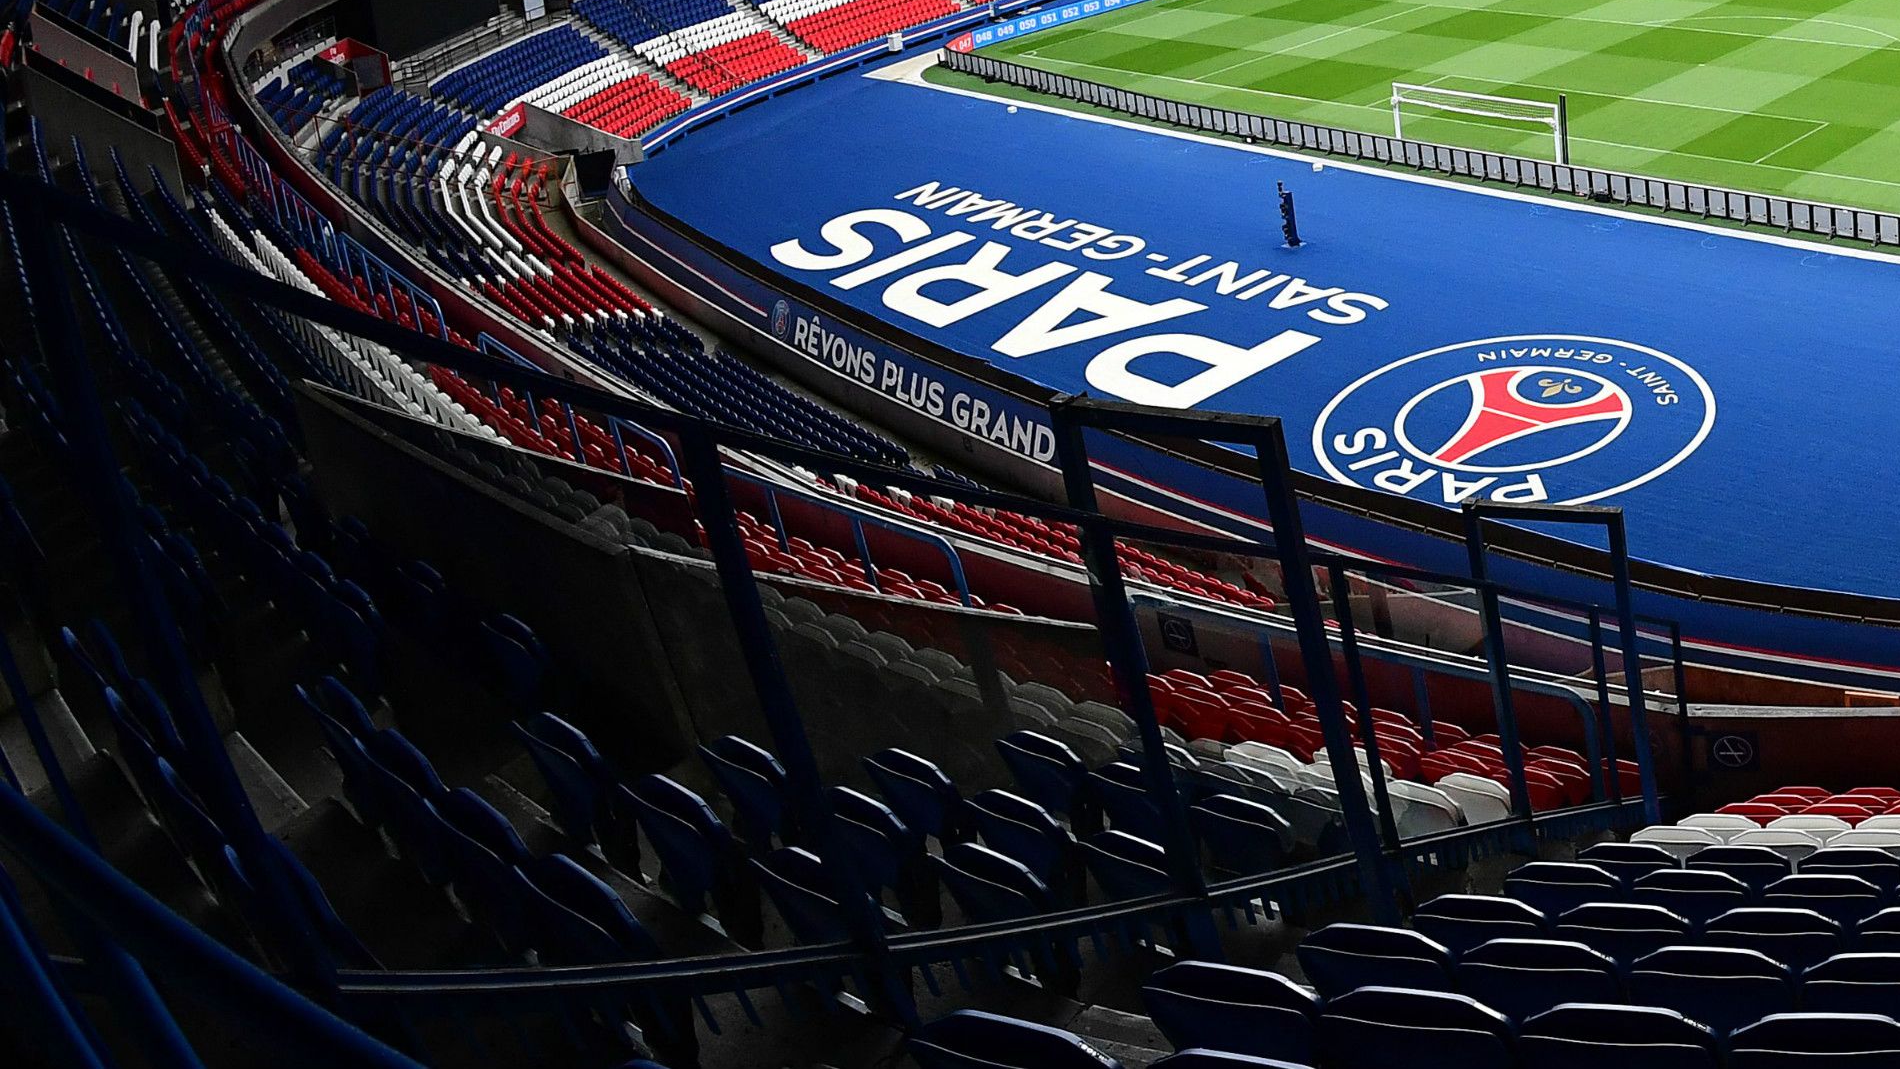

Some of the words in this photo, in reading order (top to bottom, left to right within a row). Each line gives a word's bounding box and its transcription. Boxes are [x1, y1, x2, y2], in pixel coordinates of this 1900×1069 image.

[959, 38, 971, 50] 047
[976, 31, 992, 43] 048
[998, 25, 1014, 36] 049
[1020, 19, 1036, 30] 050
[1041, 13, 1057, 24] 051
[1063, 7, 1079, 18] 052
[1084, 1, 1099, 12] 053
[770, 208, 1322, 410] PARIS
[894, 181, 1389, 325] SAINT-GERMAIN
[794, 315, 876, 384] RÊVONS
[880, 358, 944, 417] PLUS
[951, 391, 1056, 463] GRAND
[1334, 426, 1549, 511] PARIS
